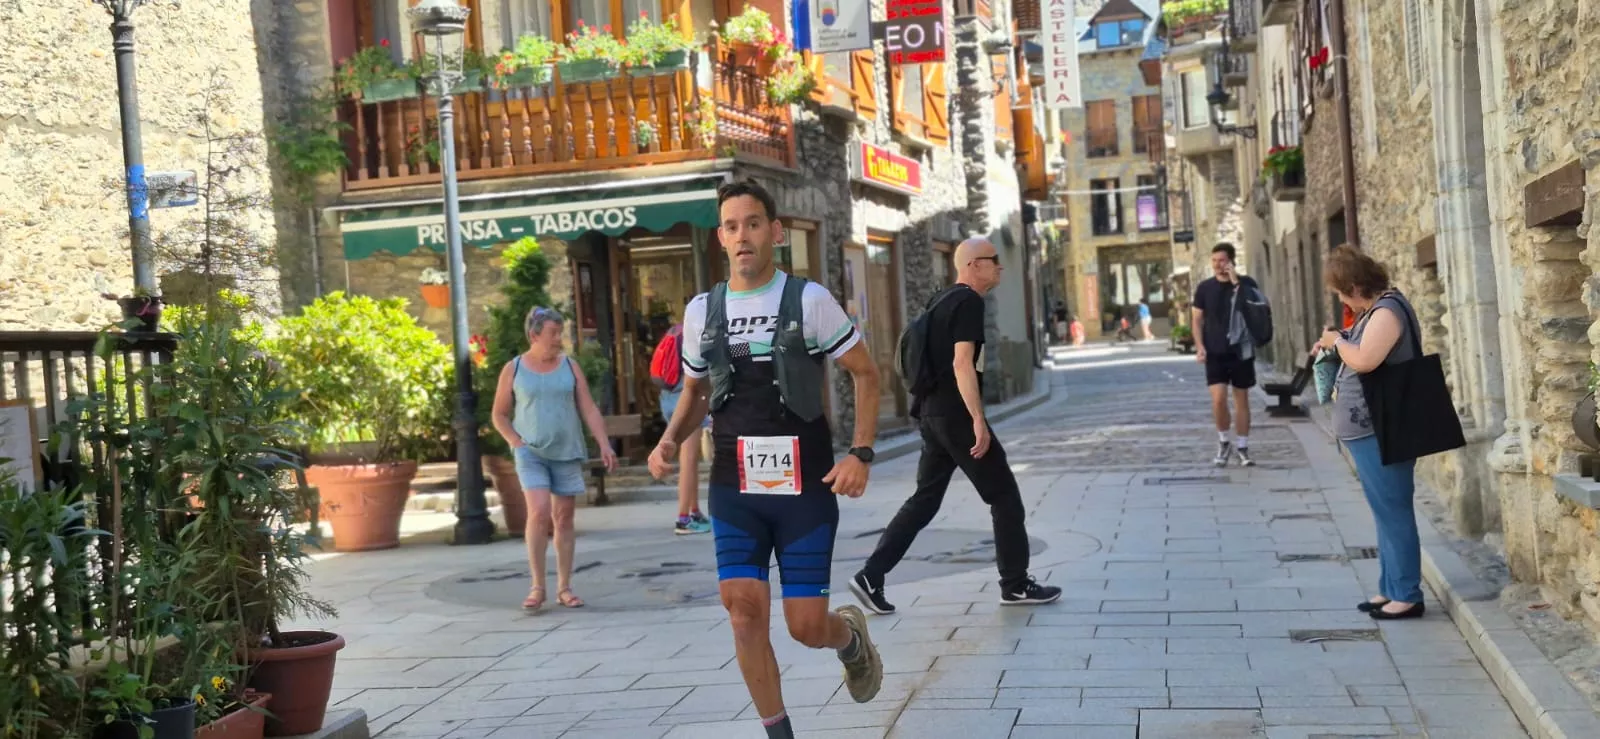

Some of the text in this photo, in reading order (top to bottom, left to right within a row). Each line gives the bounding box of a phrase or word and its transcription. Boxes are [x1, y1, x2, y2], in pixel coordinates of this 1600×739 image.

[417, 219, 503, 245] PRNSA
[530, 206, 637, 235] TABACOS
[746, 453, 792, 468] 1714
